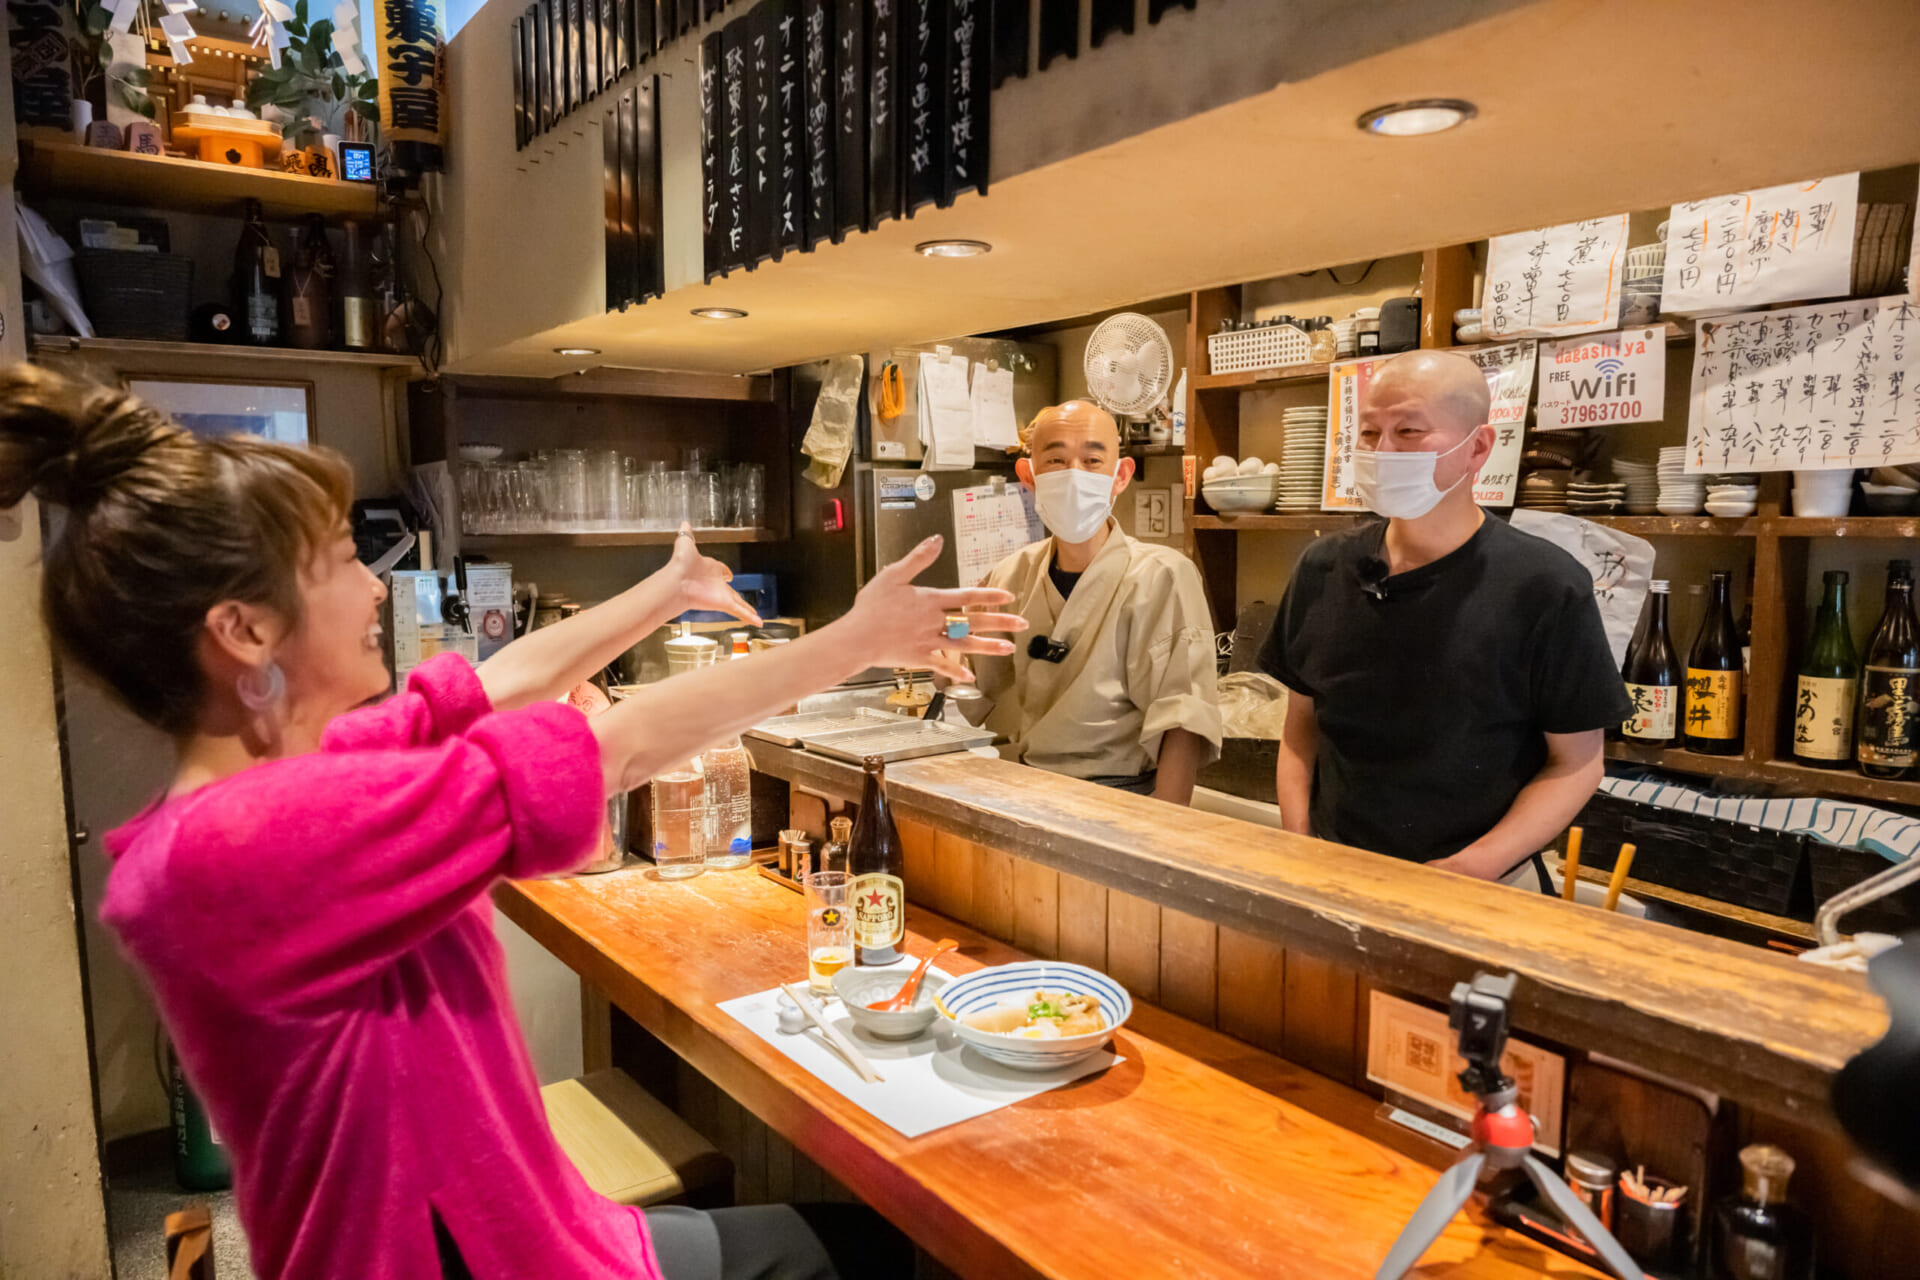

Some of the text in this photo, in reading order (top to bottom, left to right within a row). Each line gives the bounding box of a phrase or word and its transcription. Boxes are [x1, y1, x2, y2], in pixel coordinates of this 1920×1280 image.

[754, 35, 768, 193] フルーツトマト
[779, 16, 795, 236] オニオンスライス
[725, 46, 744, 252] 駄菓子屋さらだ
[1747, 210, 1775, 280] 唐揚げ
[1556, 338, 1646, 365] dagashiya
[1549, 370, 1636, 401] FREE Wifi
[1560, 400, 1642, 425] 37963700
[1498, 429, 1517, 447] 子
[1481, 474, 1515, 486] あります
[1472, 490, 1504, 502] ouza
[859, 910, 894, 922] SAPPORO
